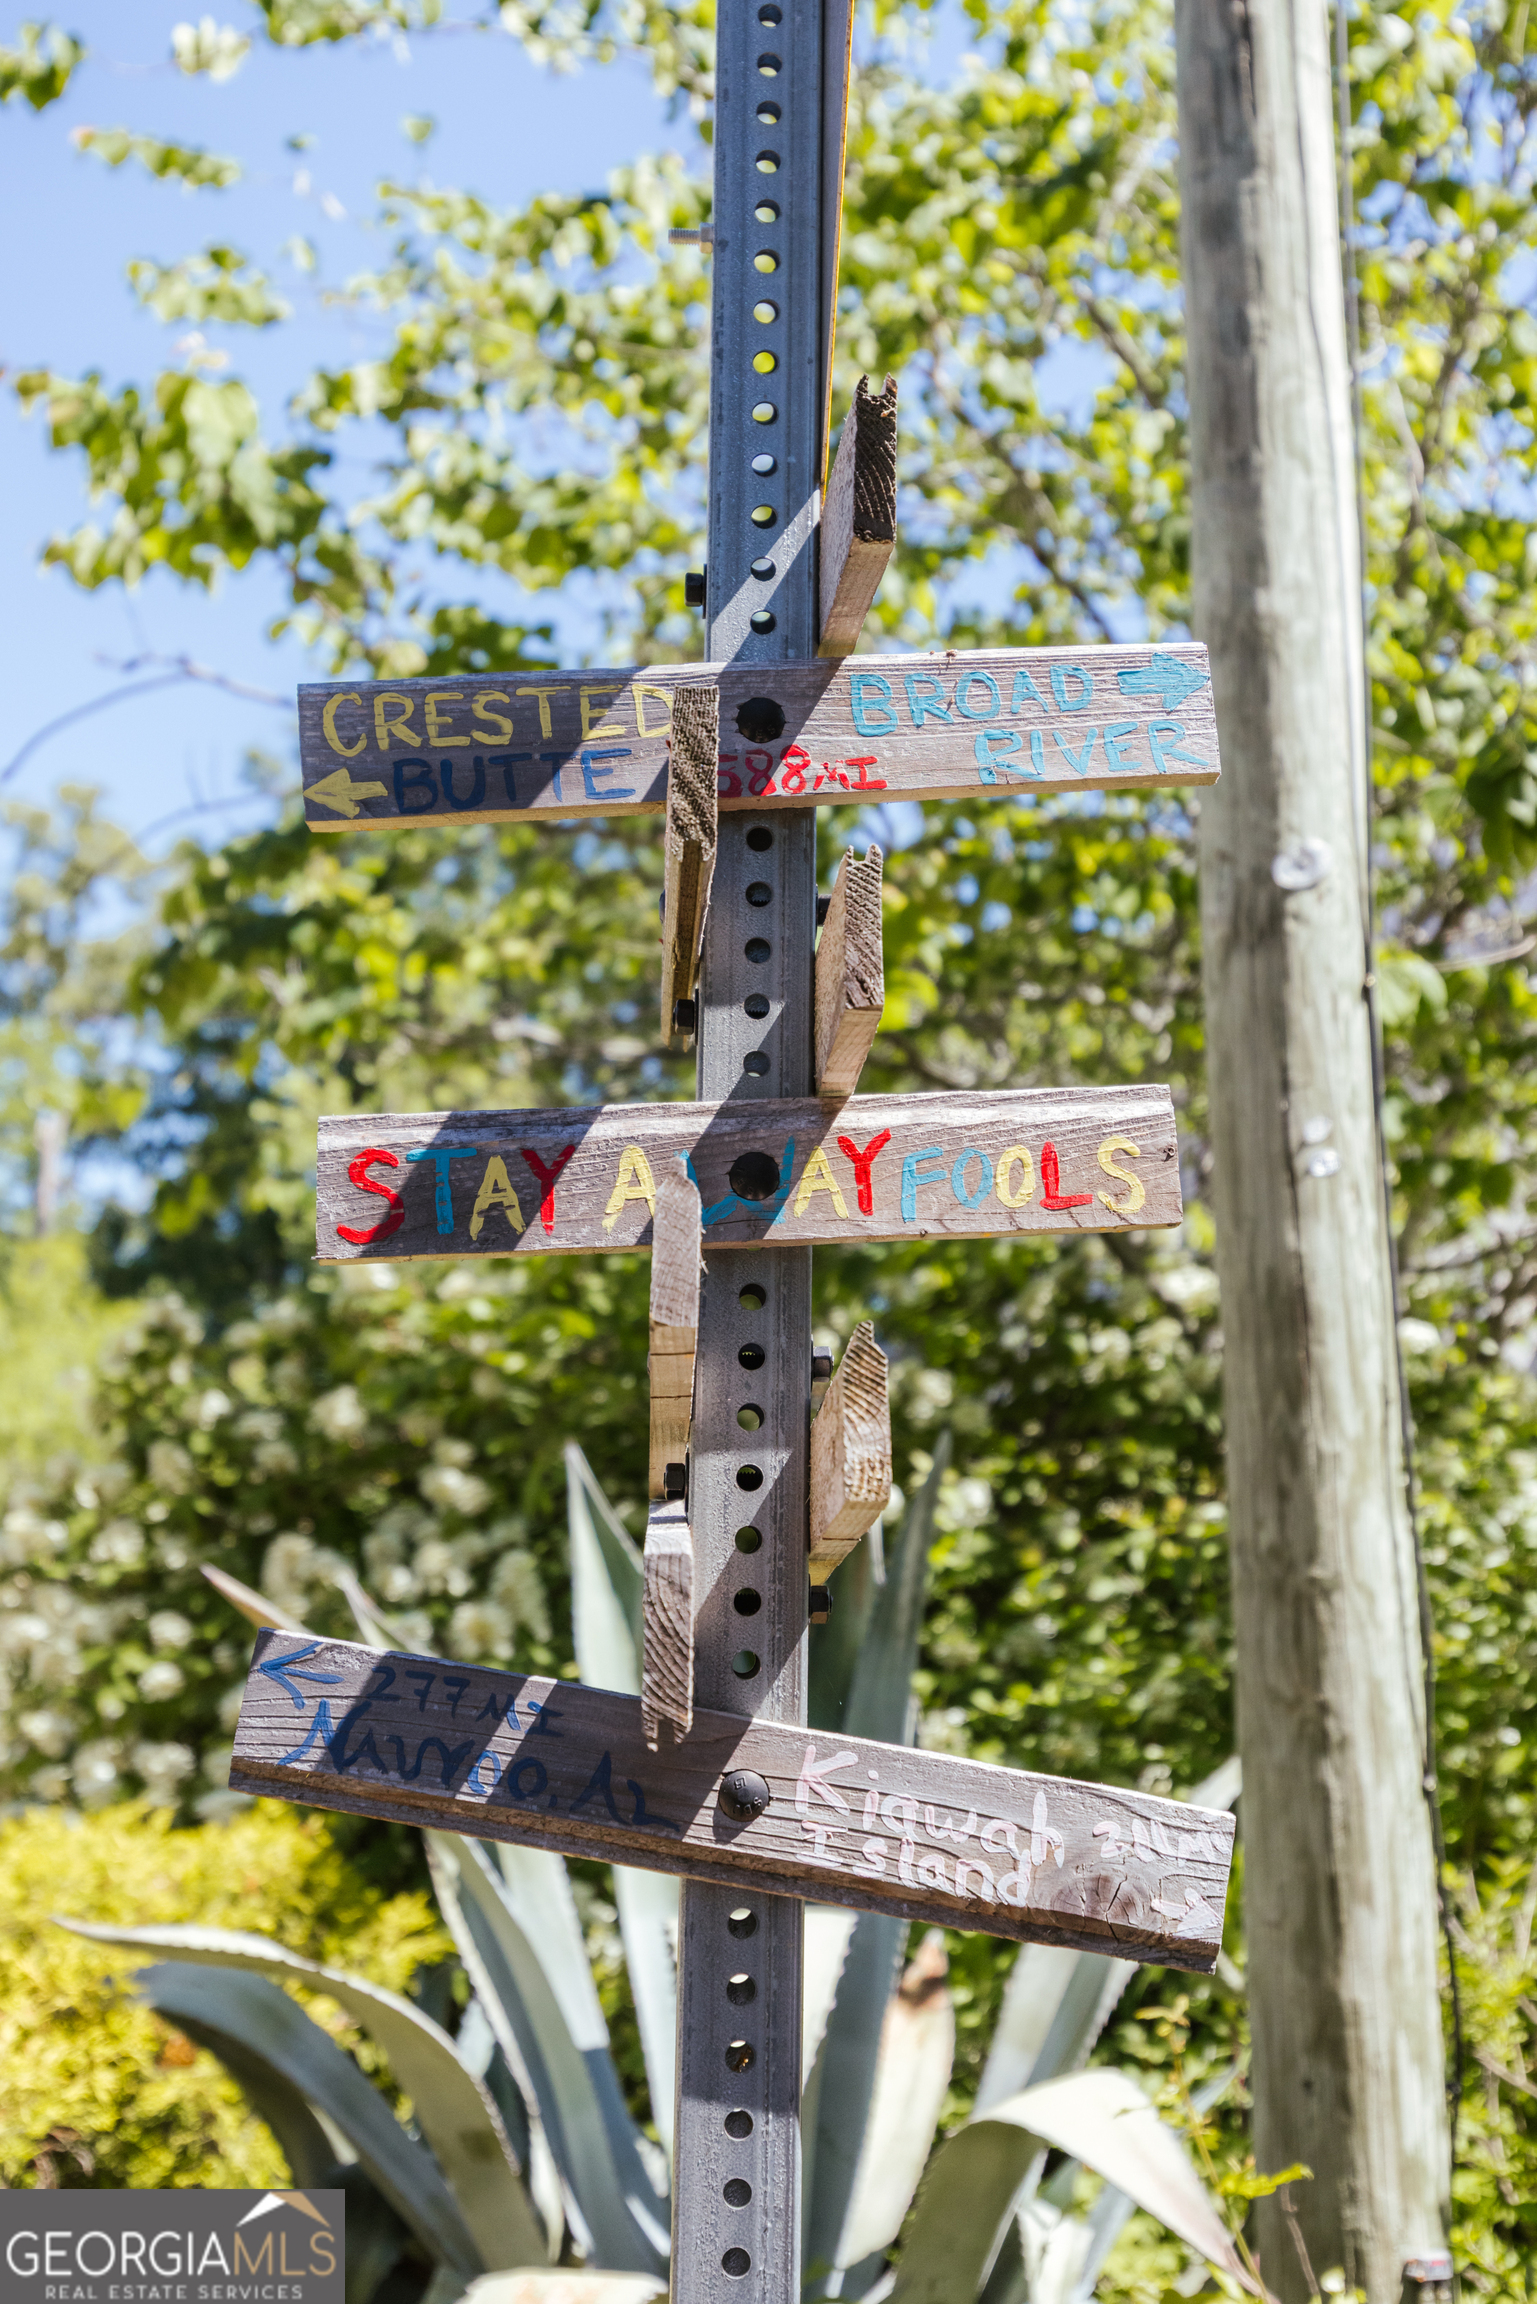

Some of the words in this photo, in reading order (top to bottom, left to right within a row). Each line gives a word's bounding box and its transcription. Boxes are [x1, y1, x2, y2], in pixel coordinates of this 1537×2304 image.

[321, 683, 673, 758] CRESTED
[850, 664, 1094, 737] BROAD
[392, 747, 637, 815] BUTTE
[973, 719, 1209, 786] RIVER
[336, 1144, 577, 1245] STAY
[901, 1134, 1148, 1223] FOOLS
[366, 1665, 471, 1720] 277
